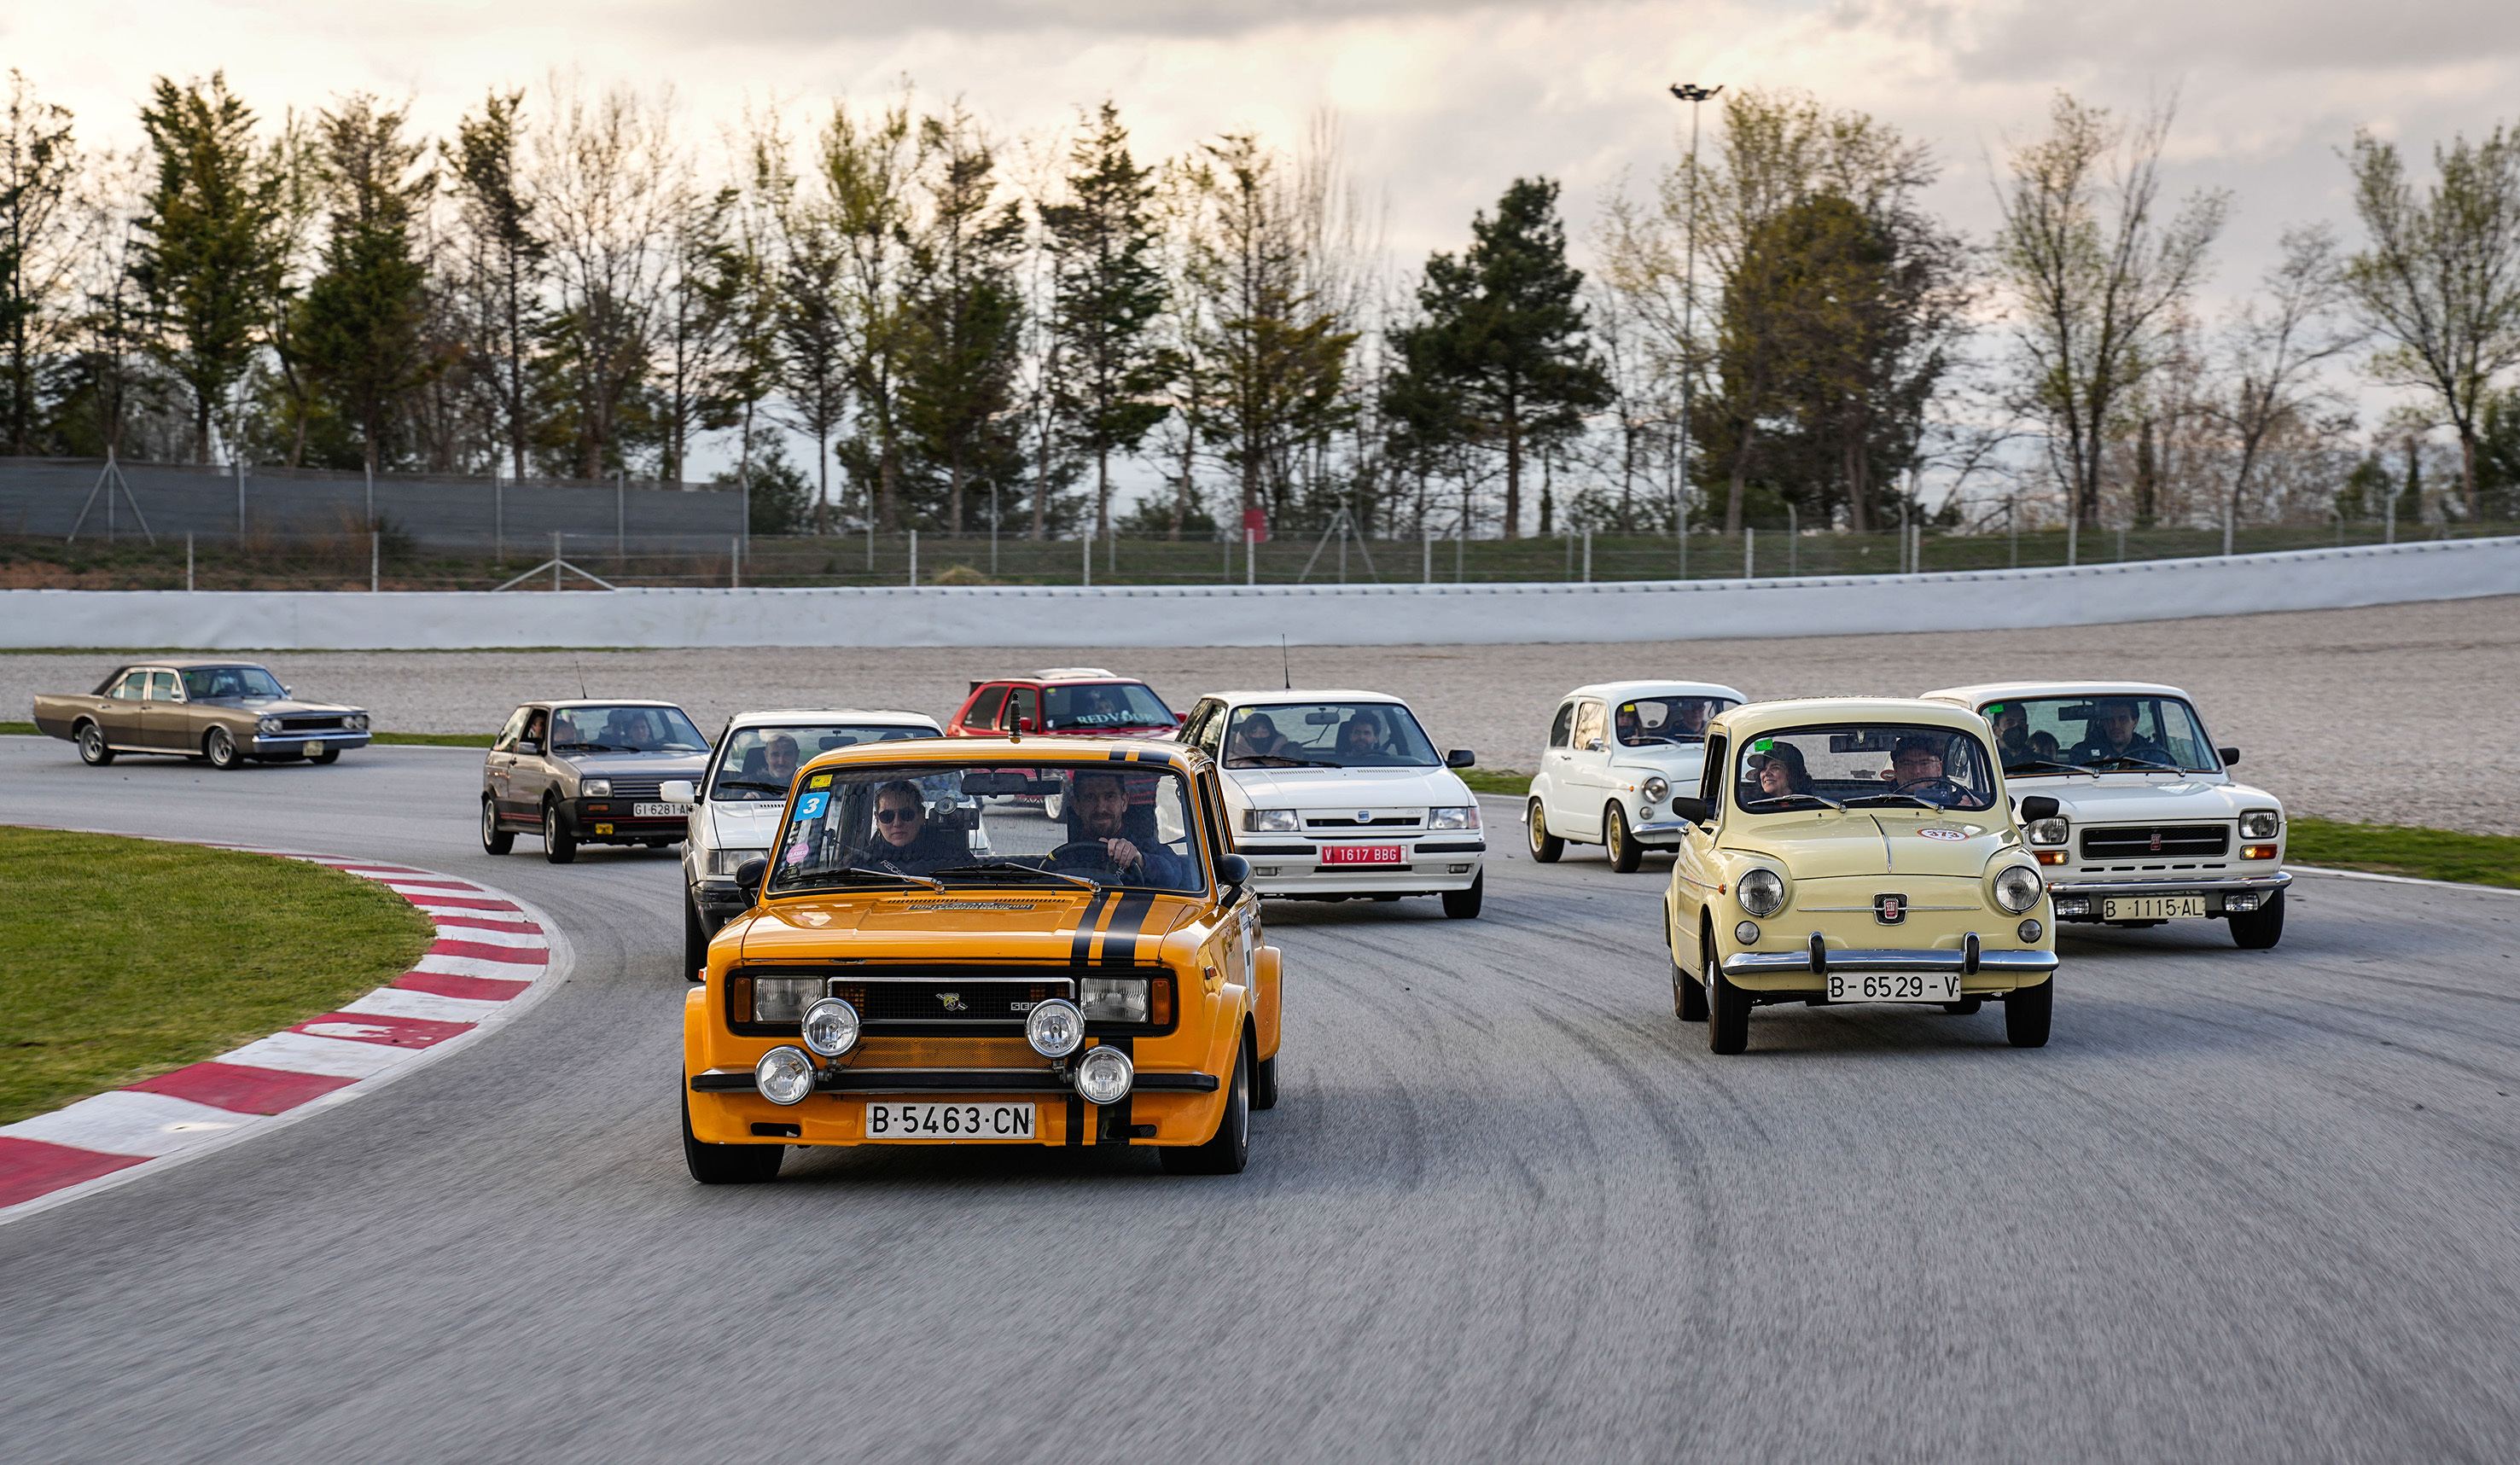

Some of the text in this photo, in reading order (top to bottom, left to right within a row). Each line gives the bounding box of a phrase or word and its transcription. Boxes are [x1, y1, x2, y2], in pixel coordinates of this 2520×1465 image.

[803, 797, 820, 814] 3
[1324, 849, 1397, 861] V 1617 BBG
